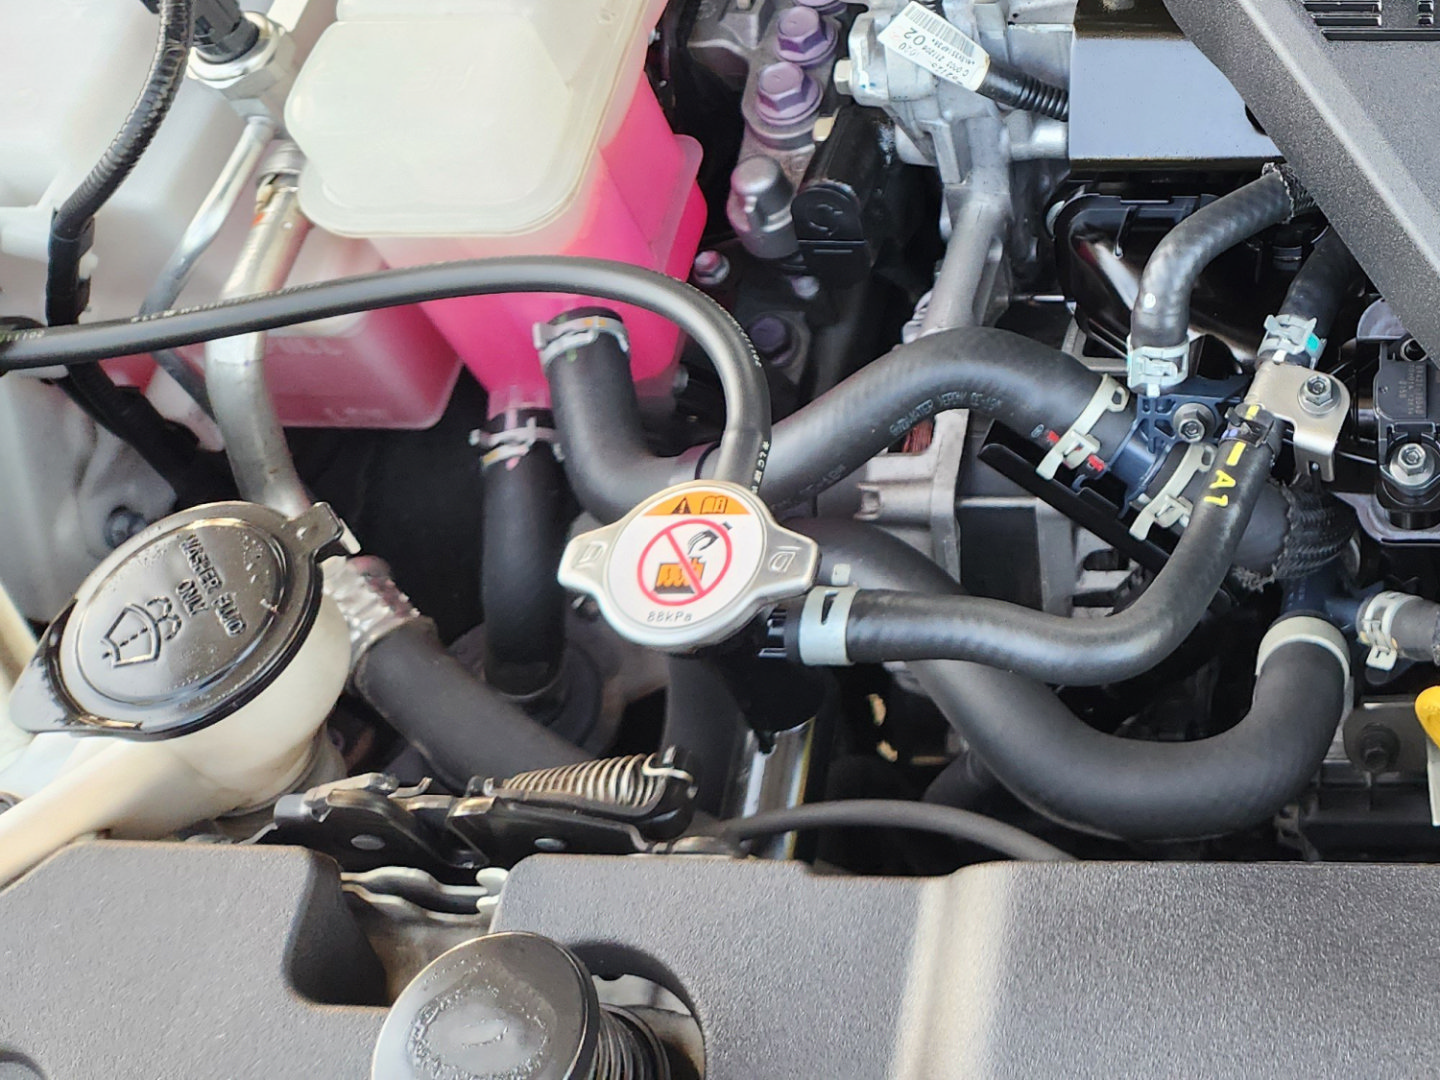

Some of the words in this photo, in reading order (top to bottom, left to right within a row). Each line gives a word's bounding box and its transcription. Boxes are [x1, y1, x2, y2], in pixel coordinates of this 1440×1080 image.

[903, 26, 927, 46] 02
[175, 578, 210, 619] ONLY
[178, 532, 224, 596] WASHER
[211, 591, 247, 638] FLUID
[646, 610, 693, 623] 88kPa
